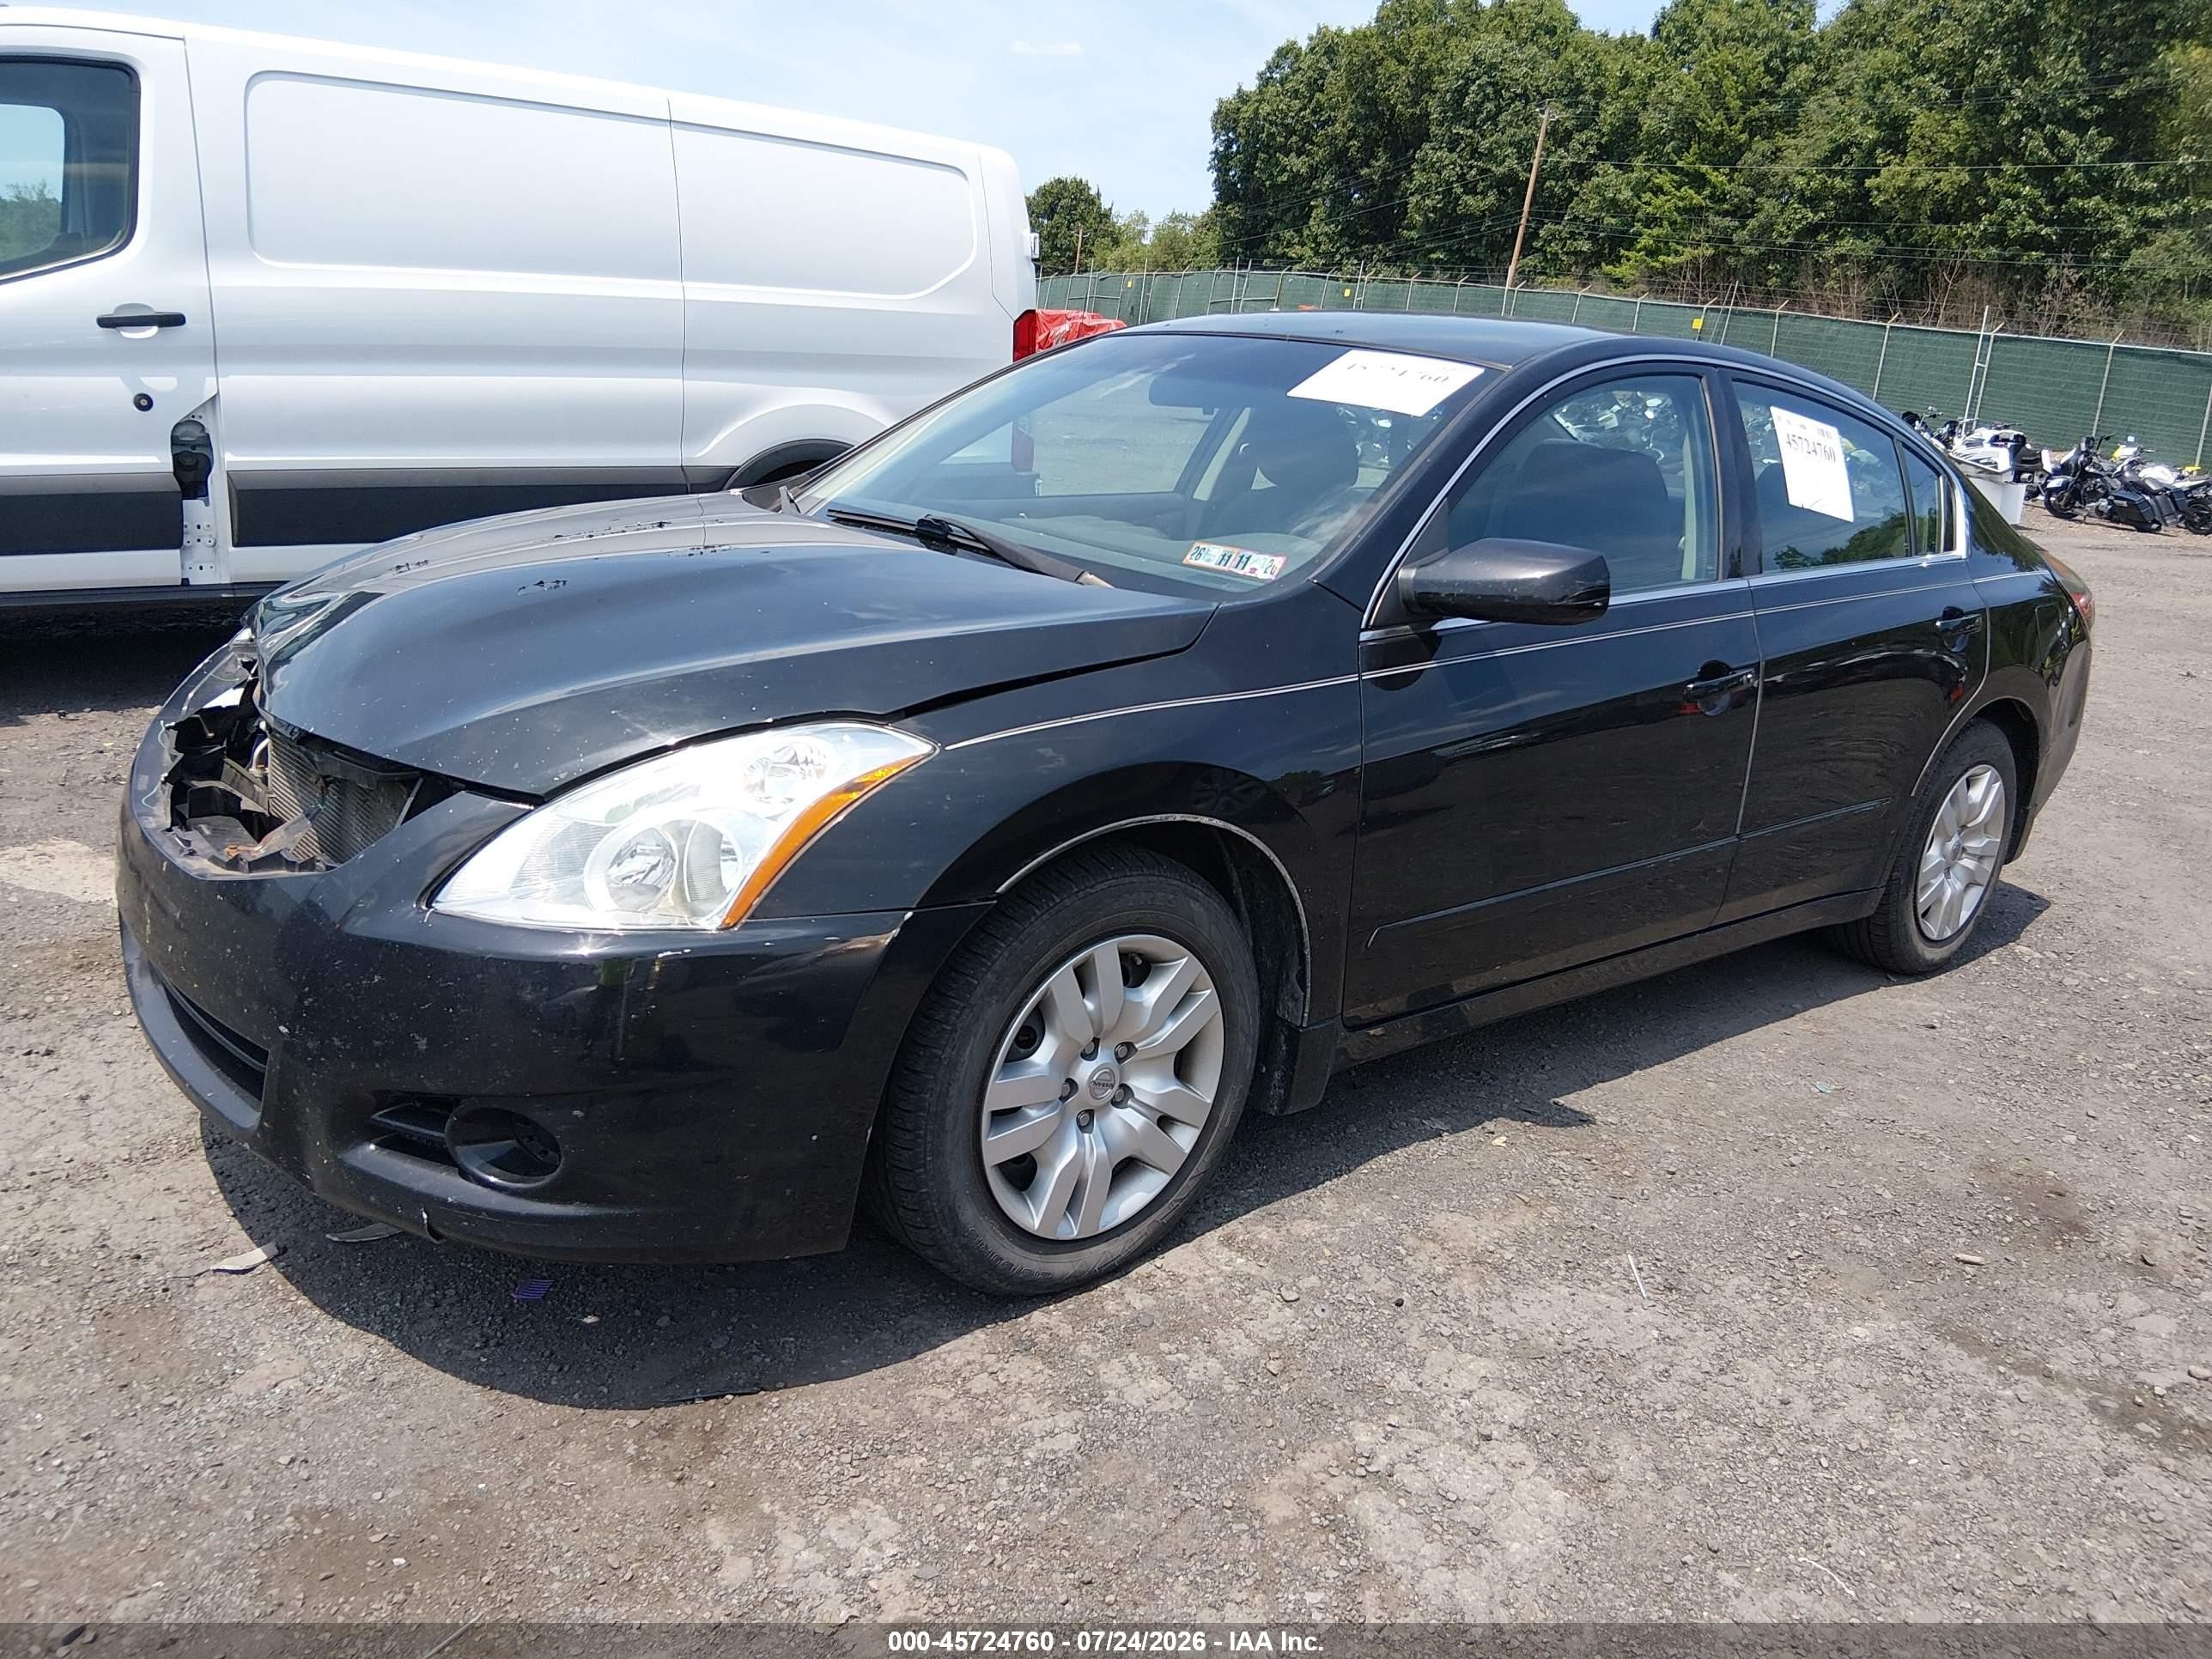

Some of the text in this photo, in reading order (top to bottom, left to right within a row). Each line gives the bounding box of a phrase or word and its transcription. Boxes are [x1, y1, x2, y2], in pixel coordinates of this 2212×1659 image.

[1785, 432, 1836, 463] 45724760
[1189, 545, 1233, 567] 26 11
[1236, 554, 1252, 570] 11
